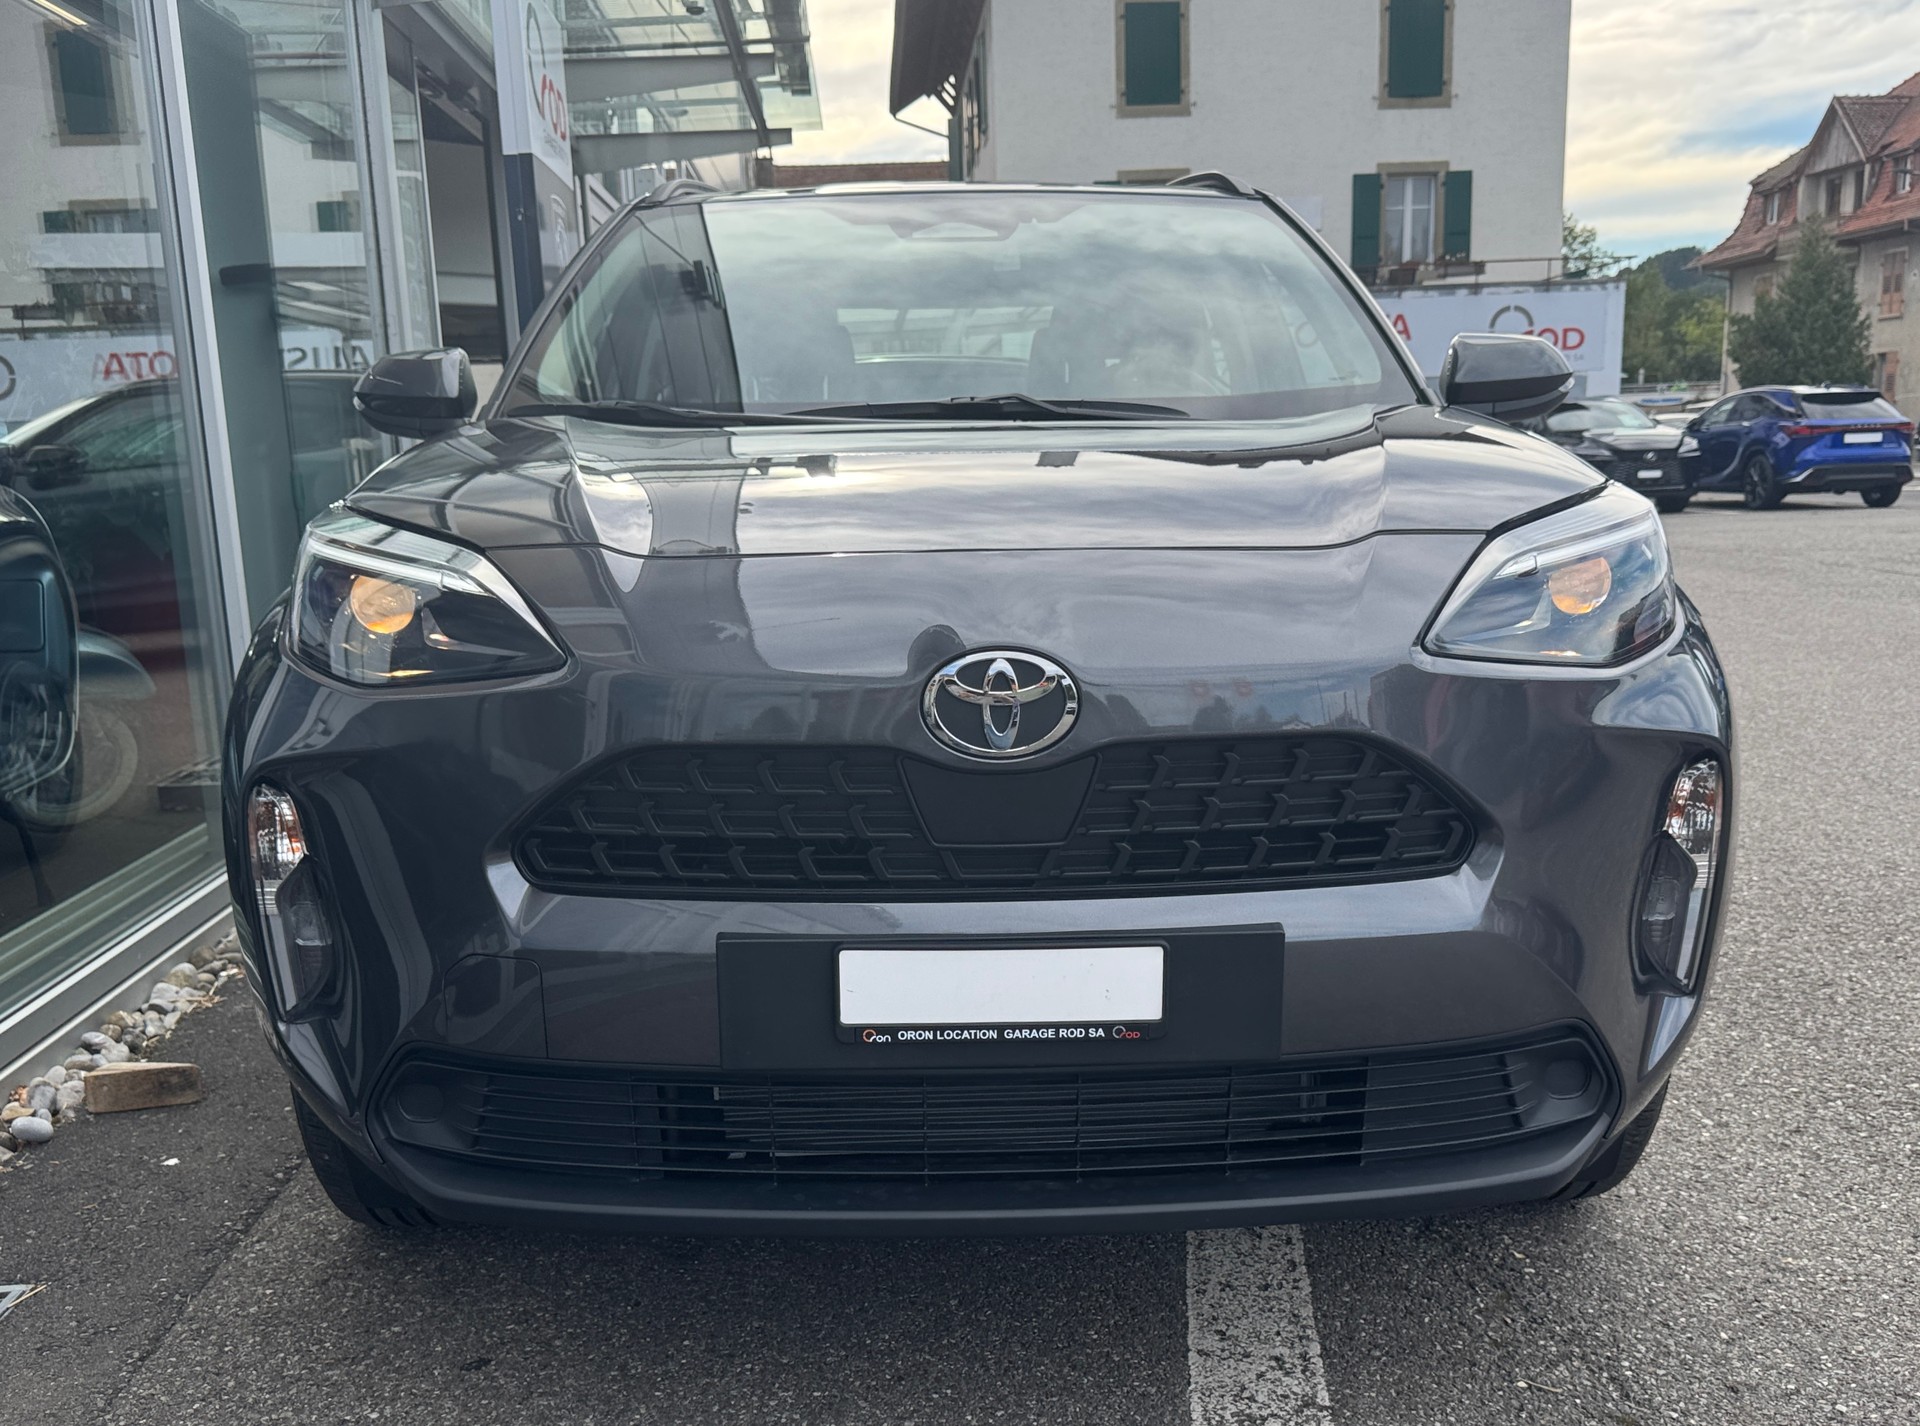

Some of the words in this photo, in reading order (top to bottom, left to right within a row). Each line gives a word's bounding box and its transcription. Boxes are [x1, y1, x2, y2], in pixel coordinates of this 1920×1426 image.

[897, 1029, 933, 1041] ORON
[936, 1029, 998, 1041] LOCATION
[1003, 1028, 1056, 1040] GARAGE
[1059, 1028, 1086, 1039] ROD
[1088, 1027, 1105, 1039] SA
